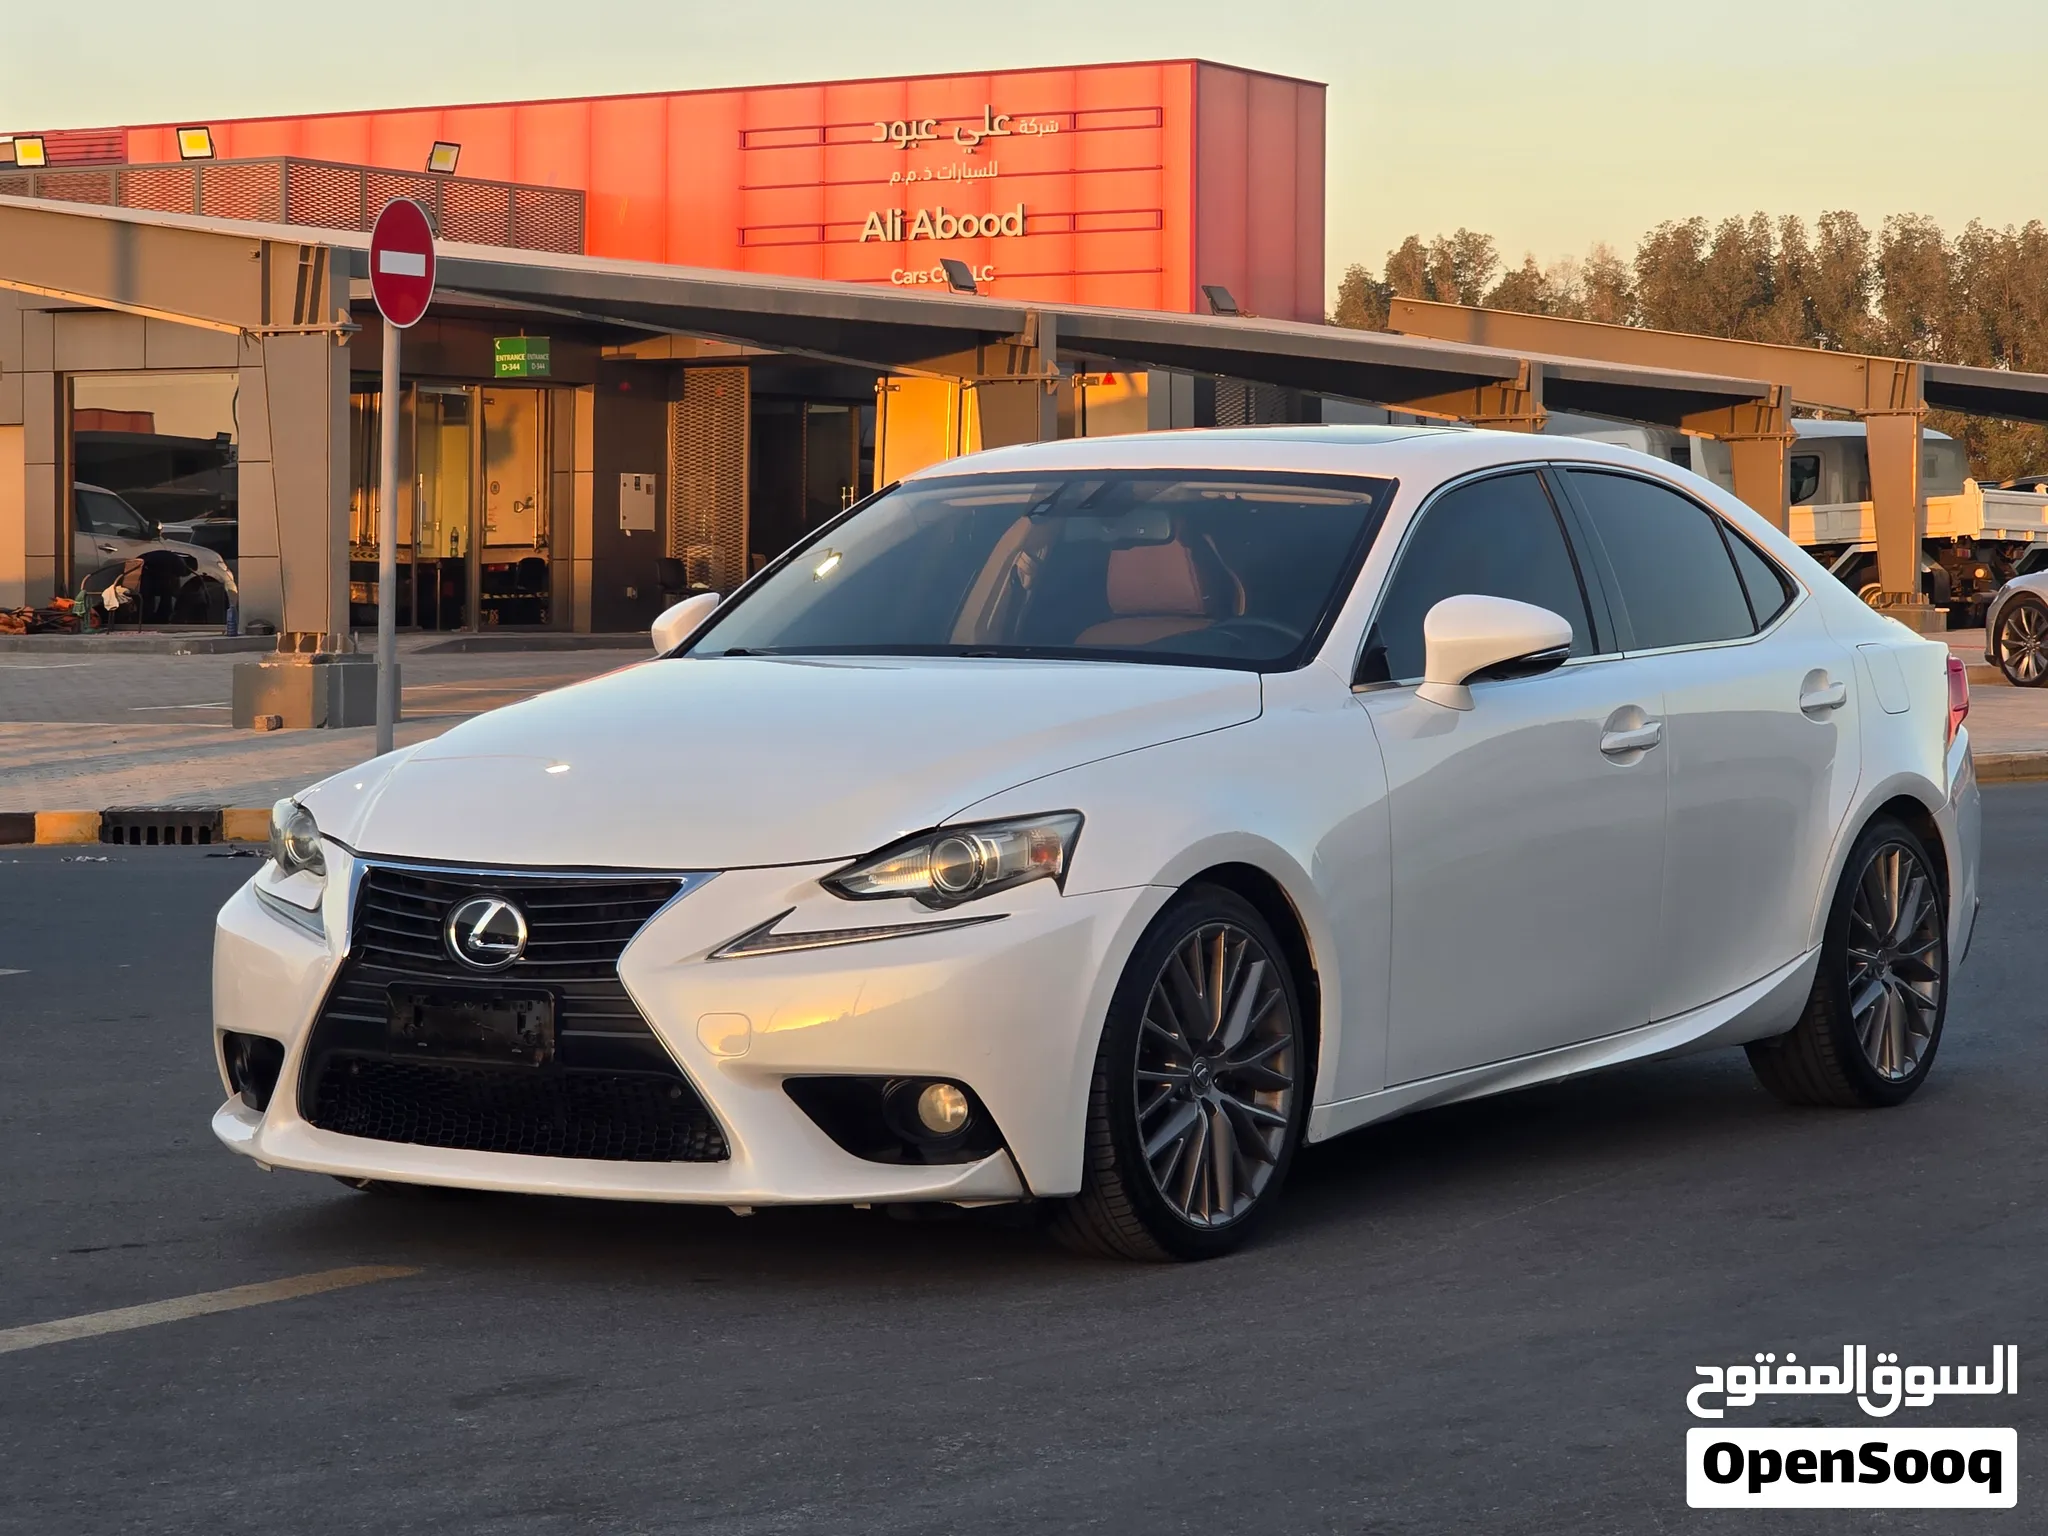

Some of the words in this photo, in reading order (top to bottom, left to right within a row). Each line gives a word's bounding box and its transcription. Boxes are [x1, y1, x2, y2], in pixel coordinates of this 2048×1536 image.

[871, 119, 938, 150] عبود
[953, 104, 1012, 153] علي
[1019, 118, 1059, 137] شركة
[937, 160, 998, 185] للسيارات
[859, 208, 904, 243] Ali
[908, 202, 1026, 240] Abood
[891, 268, 928, 284] Cars
[495, 354, 525, 362] ENTRANCE
[501, 363, 520, 371] D-344
